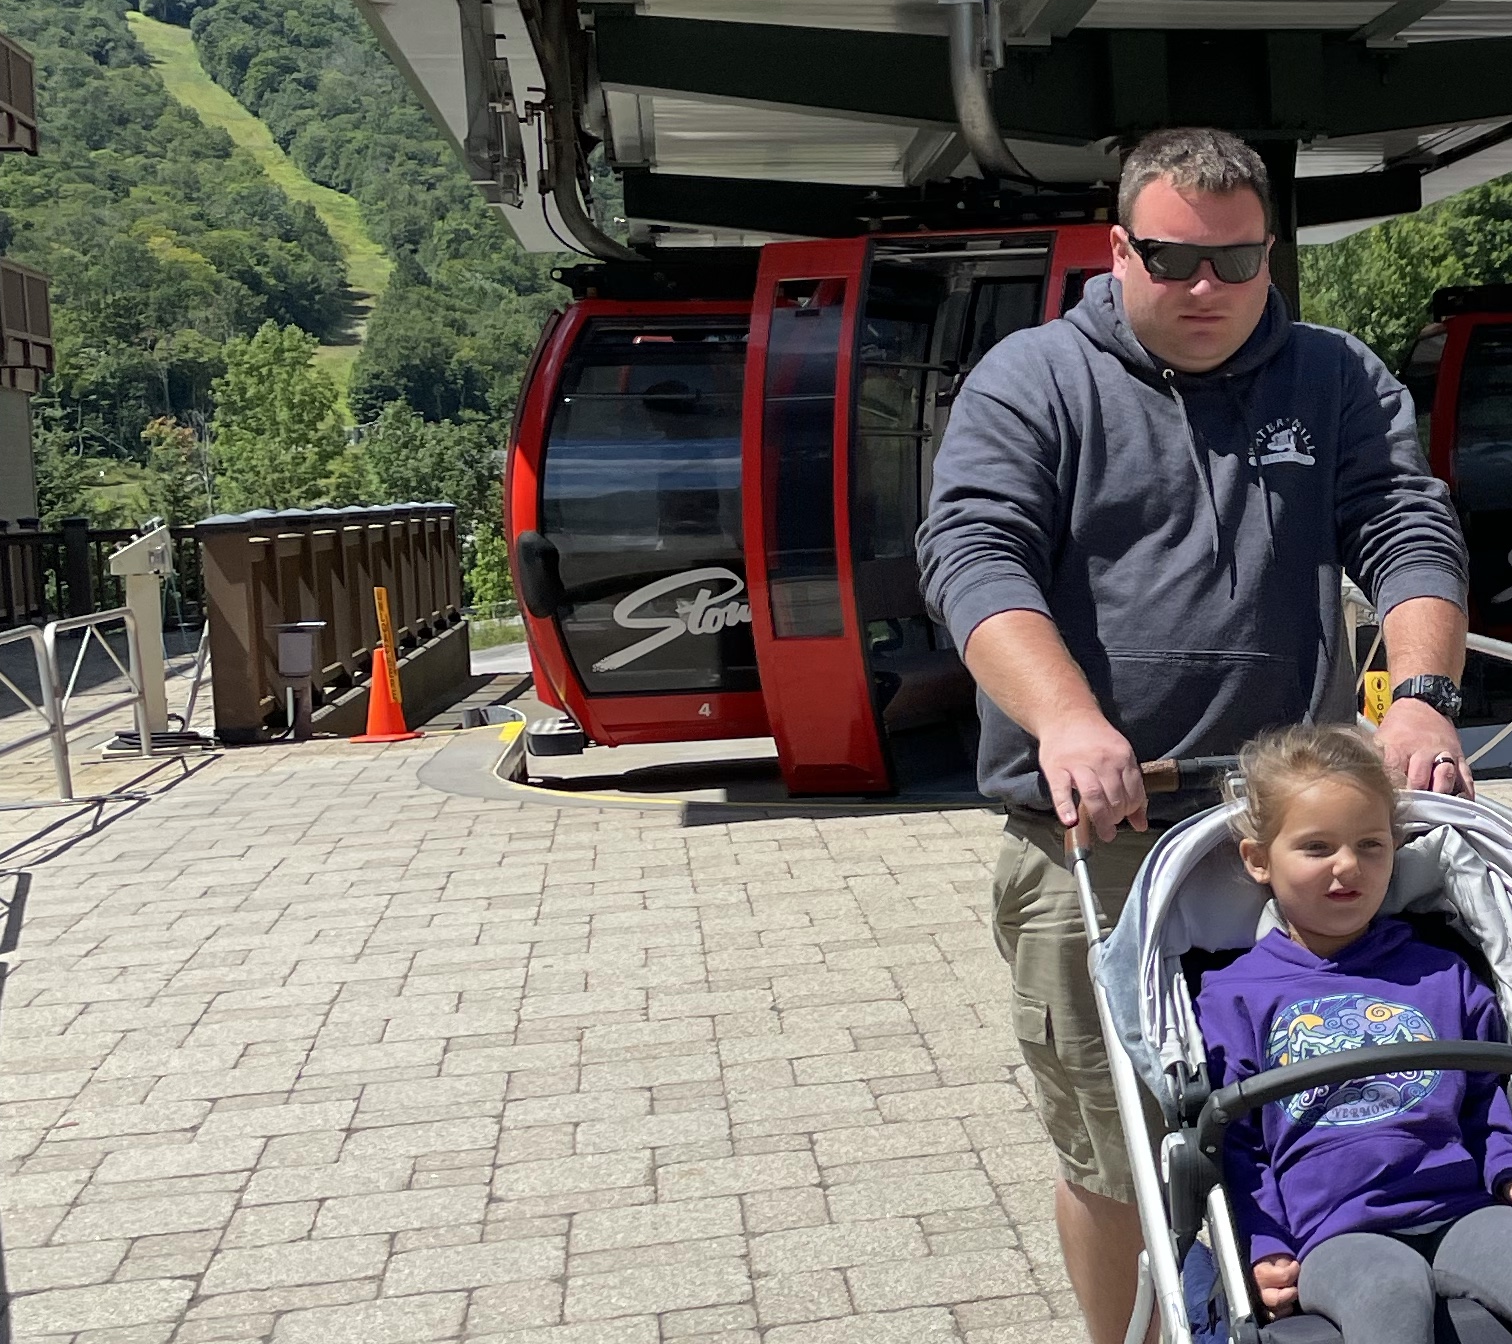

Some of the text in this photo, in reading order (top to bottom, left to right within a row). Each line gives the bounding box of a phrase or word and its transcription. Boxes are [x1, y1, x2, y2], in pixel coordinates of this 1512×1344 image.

[697, 702, 712, 717] 4
[1376, 694, 1385, 725] LOA
[1331, 1097, 1397, 1120] VERMONT
